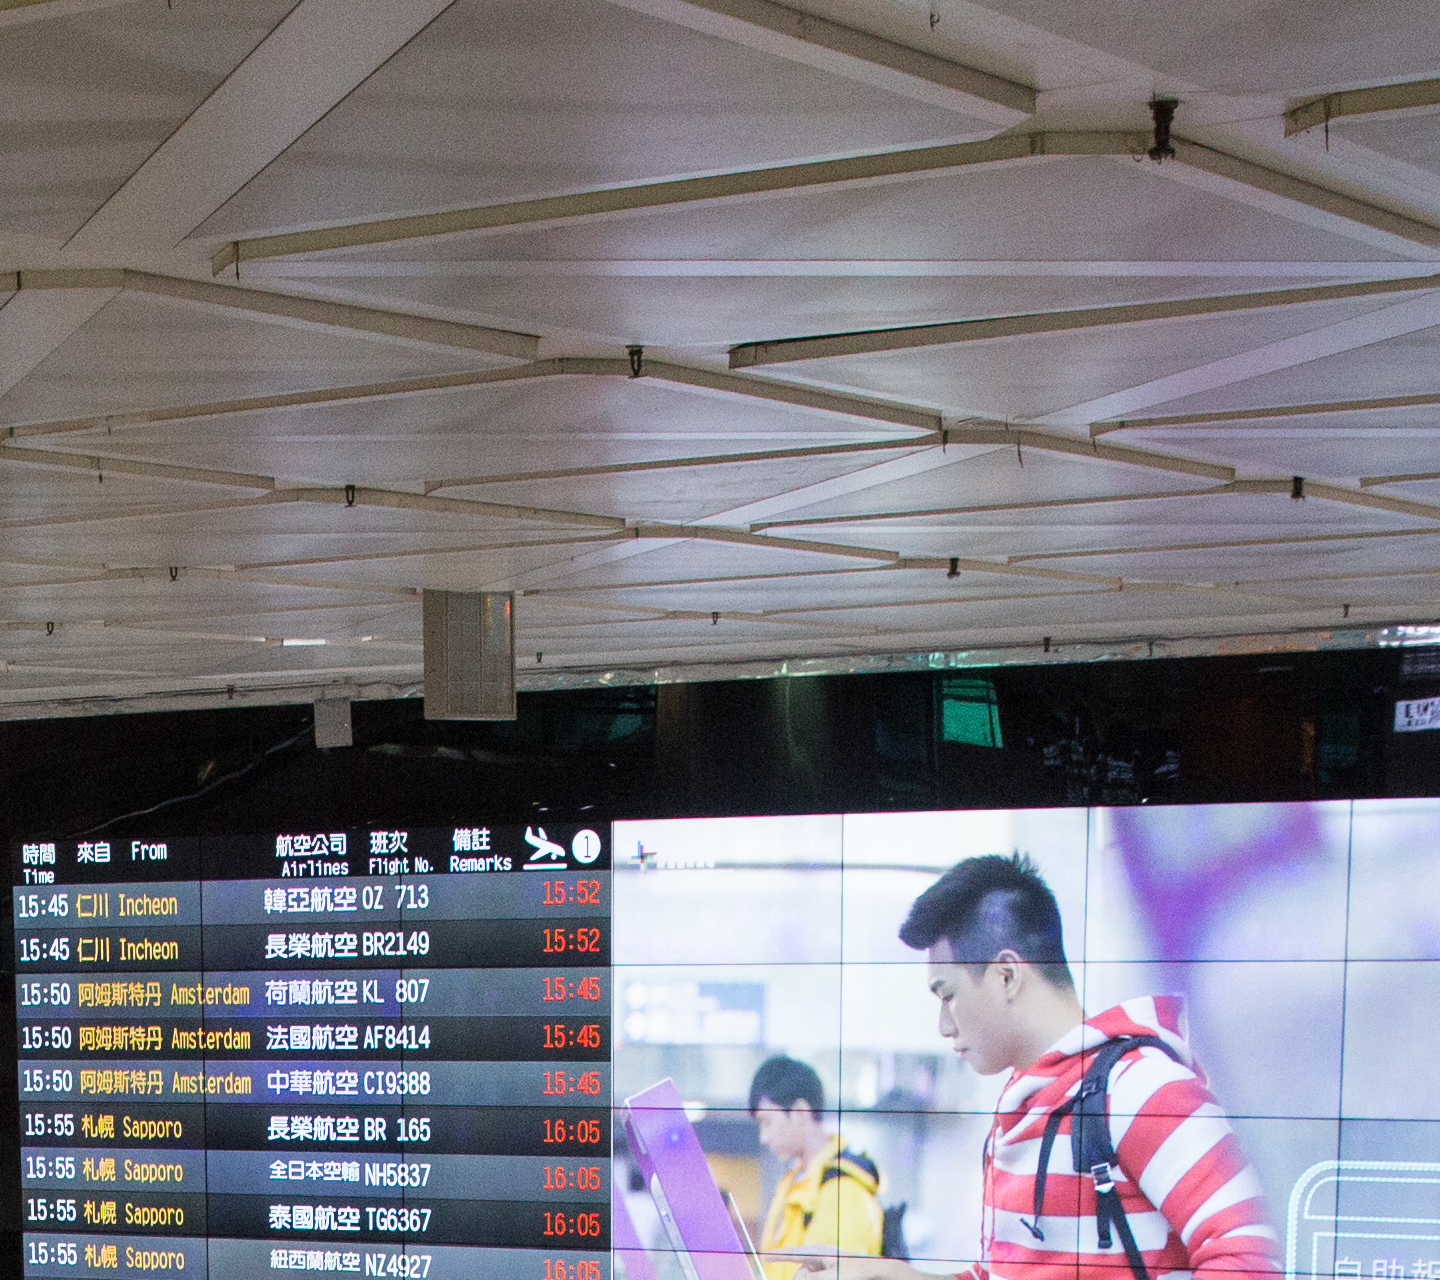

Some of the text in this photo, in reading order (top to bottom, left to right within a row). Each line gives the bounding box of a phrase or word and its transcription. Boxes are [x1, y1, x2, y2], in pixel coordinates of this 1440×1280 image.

[18, 879, 601, 918] 15:45 仁川 Incheon 韓亞航空 OZ 713 15:52
[22, 1024, 601, 1051] 15:50 阿姆斯特丹 Amsterdam 法國航空 AF8414 15:45
[26, 1155, 601, 1191] 15:55 札幌 Sapporo 全日本空輸 NH5837 16:05
